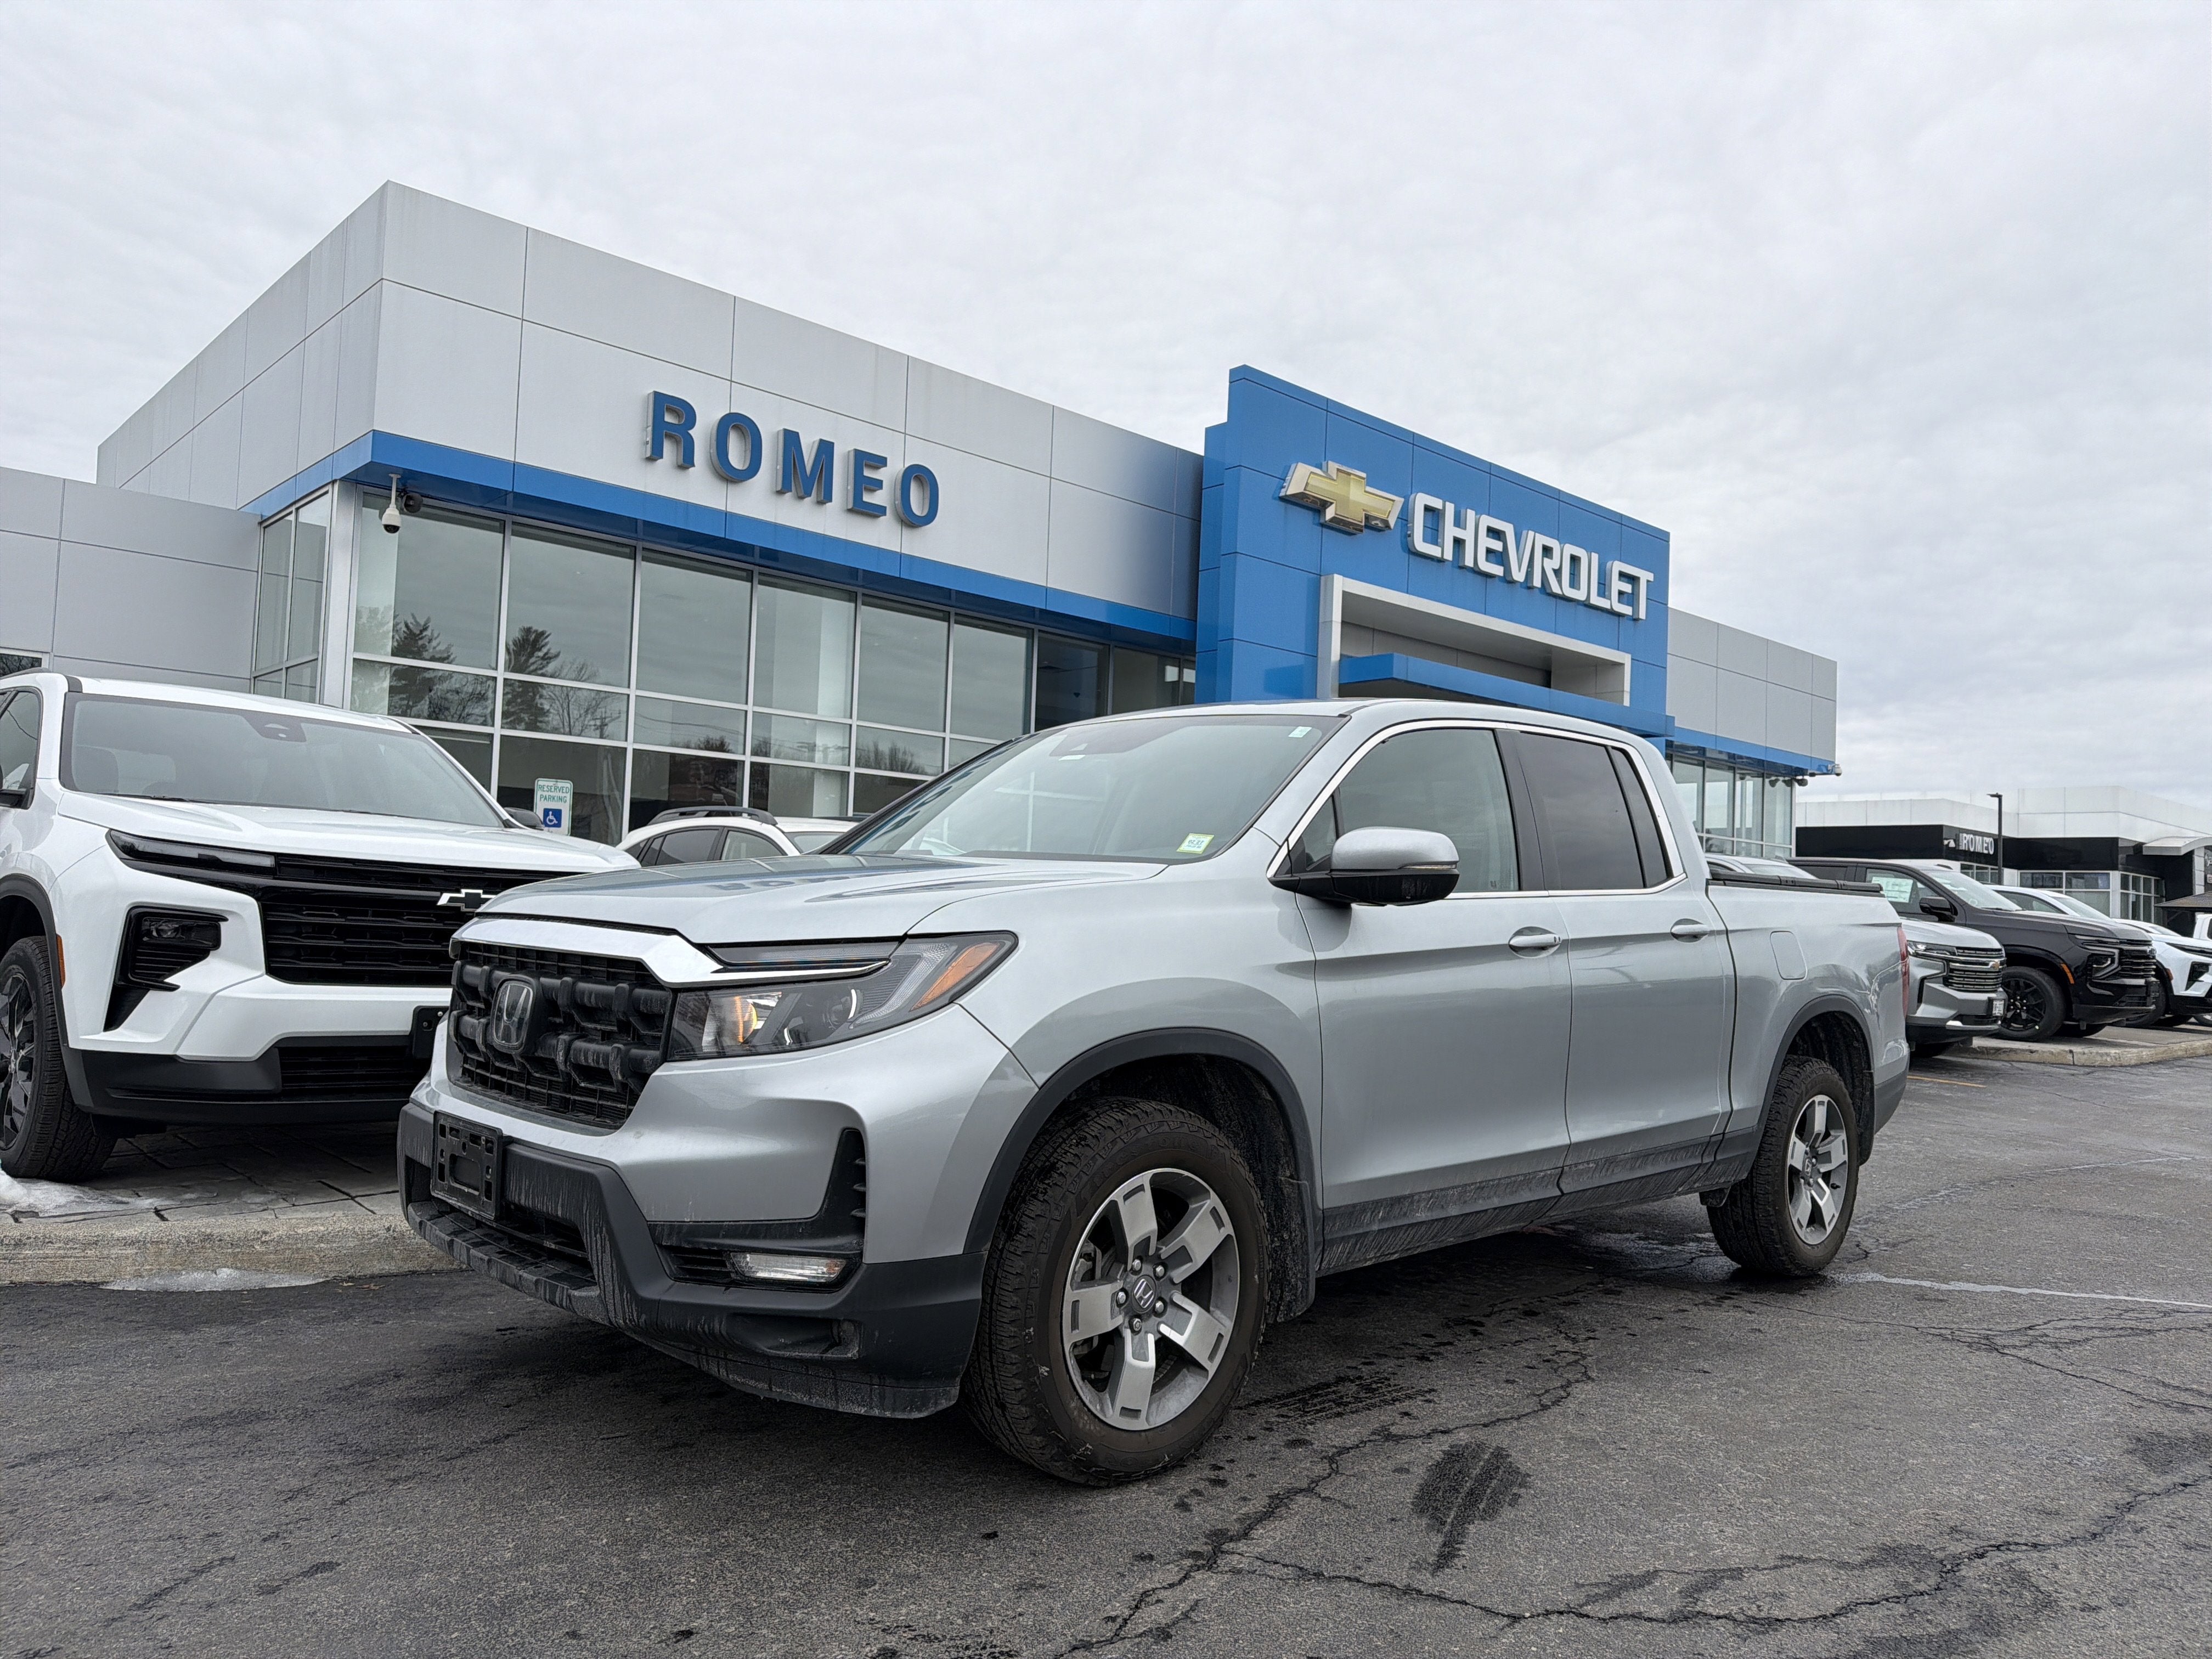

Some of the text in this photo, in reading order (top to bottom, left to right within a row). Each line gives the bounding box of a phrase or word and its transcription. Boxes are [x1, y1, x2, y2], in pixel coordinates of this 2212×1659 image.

[645, 390, 939, 528] ROMEO
[1407, 492, 1654, 620] CHEVROLET
[538, 784, 570, 794] RESERVED
[540, 794, 567, 803] PARKING
[1960, 833, 1994, 855] ROMEO
